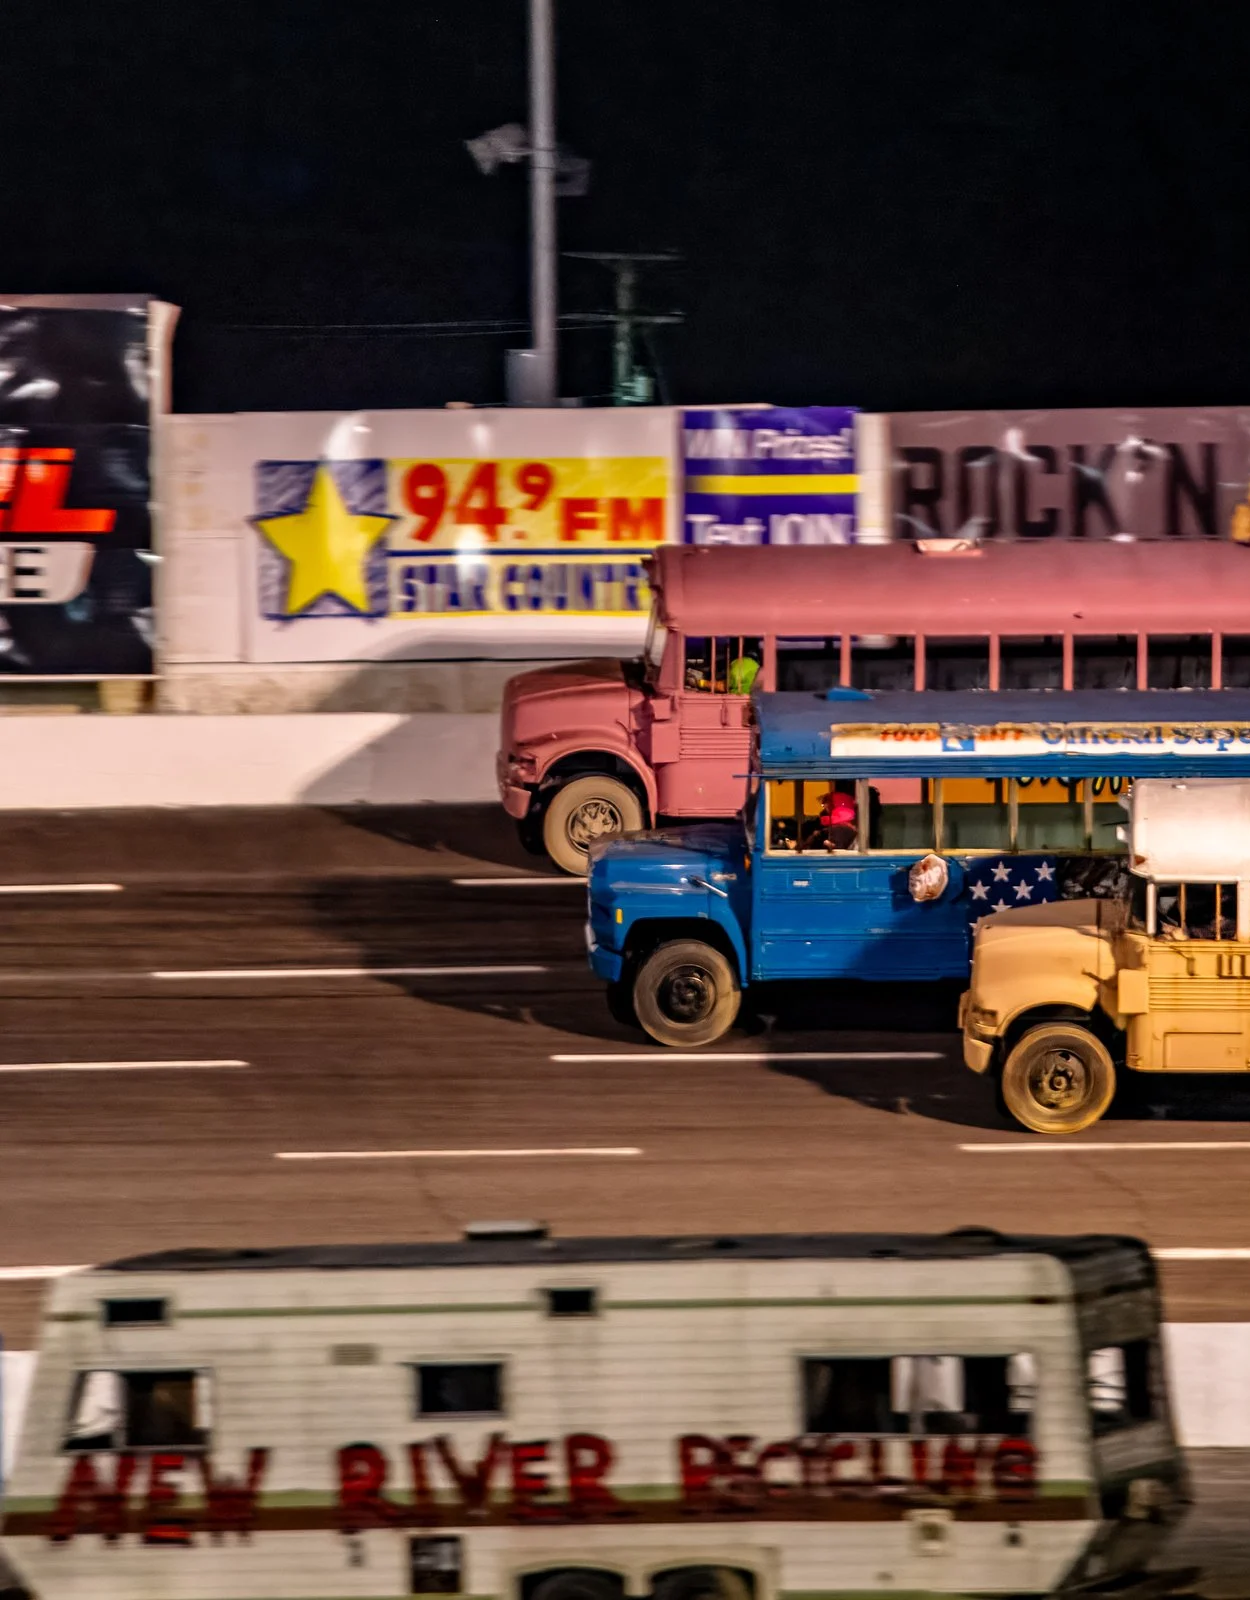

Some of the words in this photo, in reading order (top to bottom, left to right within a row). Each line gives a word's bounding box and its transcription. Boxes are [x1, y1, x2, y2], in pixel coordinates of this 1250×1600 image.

[559, 497, 664, 542] FM
[502, 562, 650, 612] COUNTR
[45, 1446, 271, 1547] NEW
[335, 1432, 638, 1535] RIVER
